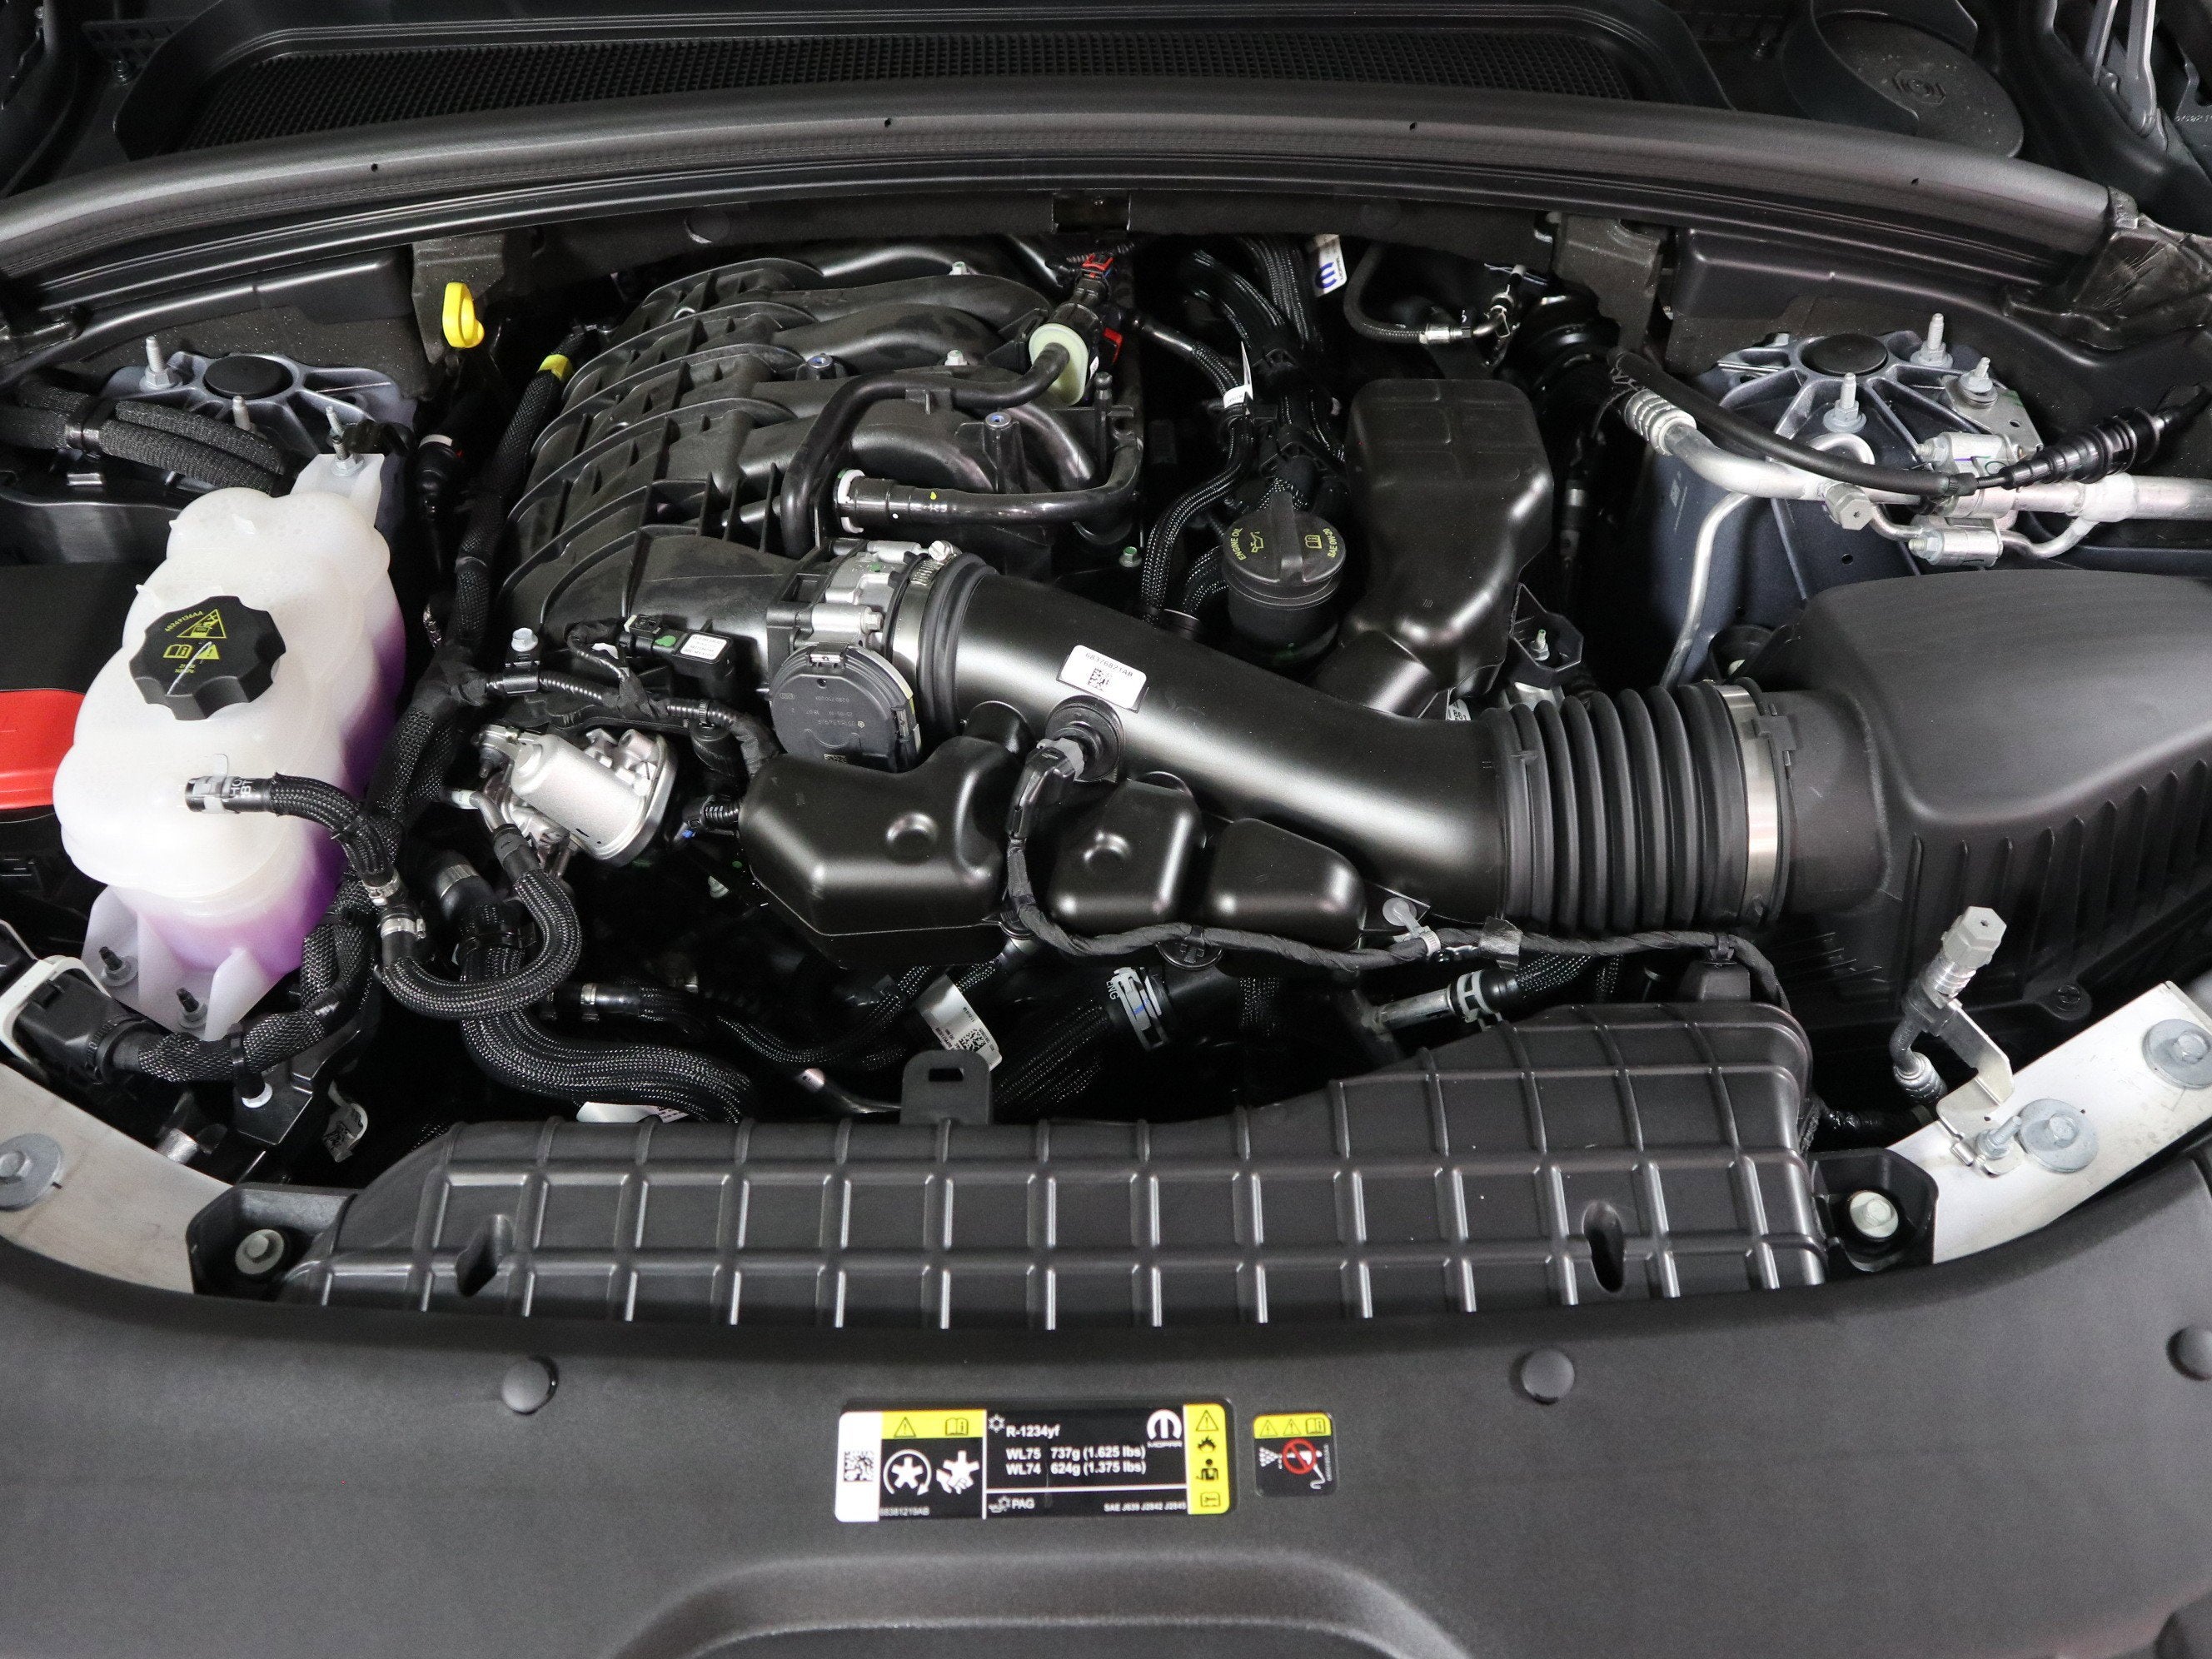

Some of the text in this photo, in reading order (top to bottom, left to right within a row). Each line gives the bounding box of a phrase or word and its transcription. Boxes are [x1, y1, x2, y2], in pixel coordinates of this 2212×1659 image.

[1230, 528, 1247, 560] ENGINE OIL
[1327, 545, 1338, 558] SAE
[1005, 1424, 1060, 1439] R-1234yf
[1005, 1444, 1146, 1462] WL75 737g (1.625 lbs)
[1005, 1459, 1147, 1477] WL74 624g (1.375 lbs)
[1012, 1497, 1035, 1509] PAG
